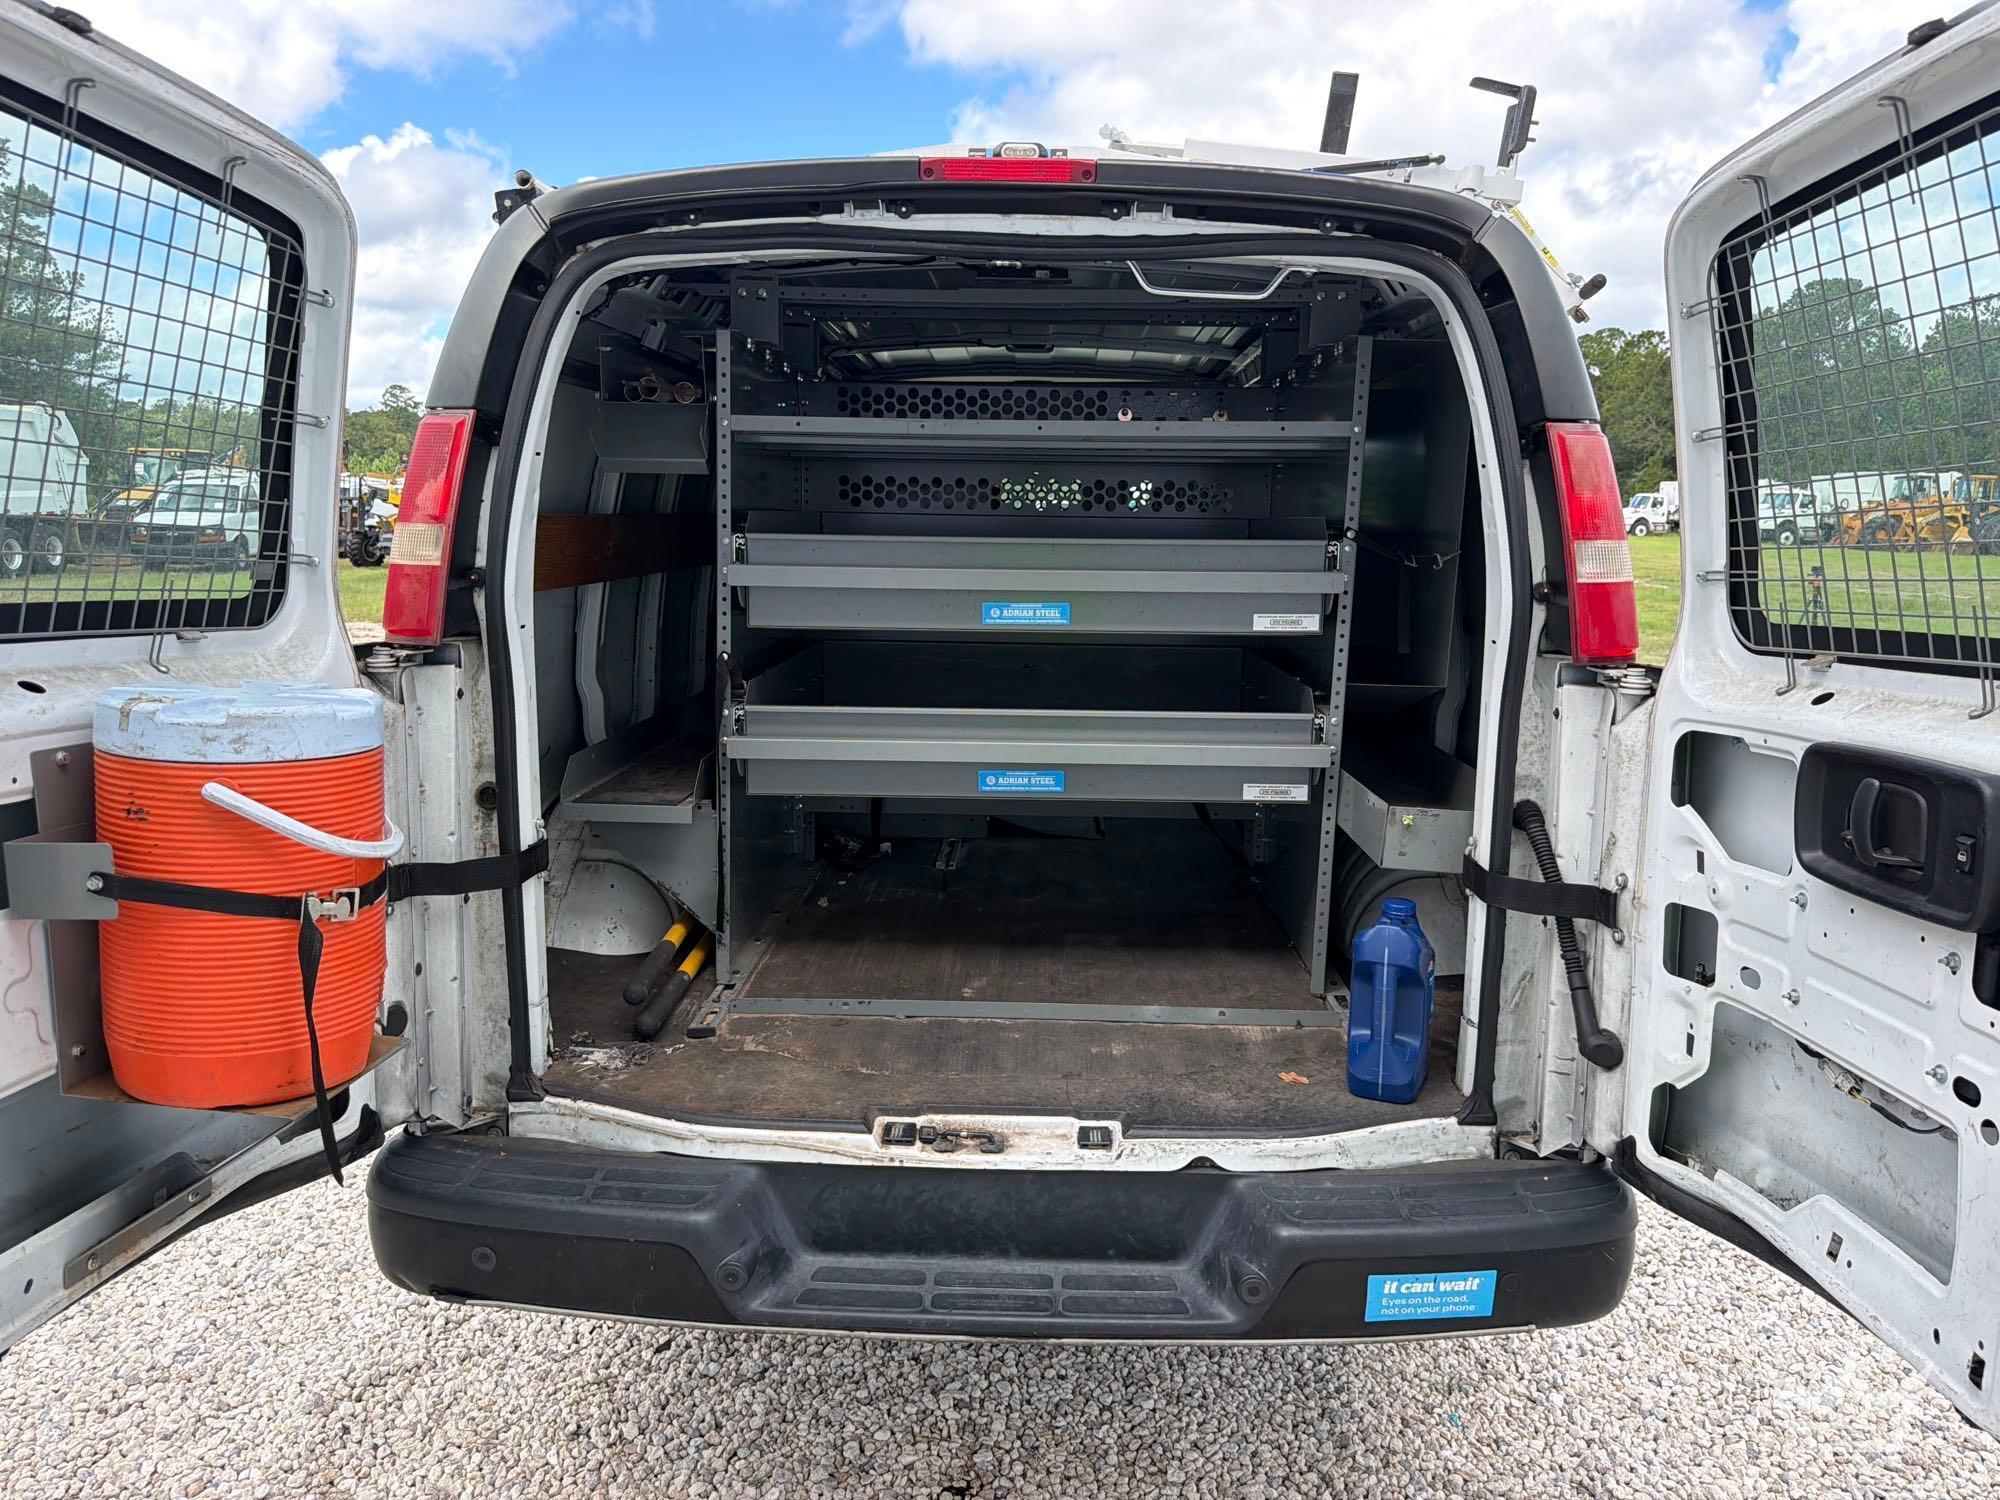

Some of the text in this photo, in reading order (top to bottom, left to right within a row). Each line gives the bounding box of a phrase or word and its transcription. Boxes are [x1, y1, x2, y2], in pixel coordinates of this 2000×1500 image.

[1002, 609, 1061, 617] ADRIAN STEEL
[997, 777, 1056, 785] ADRIAN STEEL
[1383, 1277, 1480, 1294] it can wait
[1381, 1294, 1469, 1307] Eyes on the road,
[1380, 1304, 1476, 1315] not on your phone
